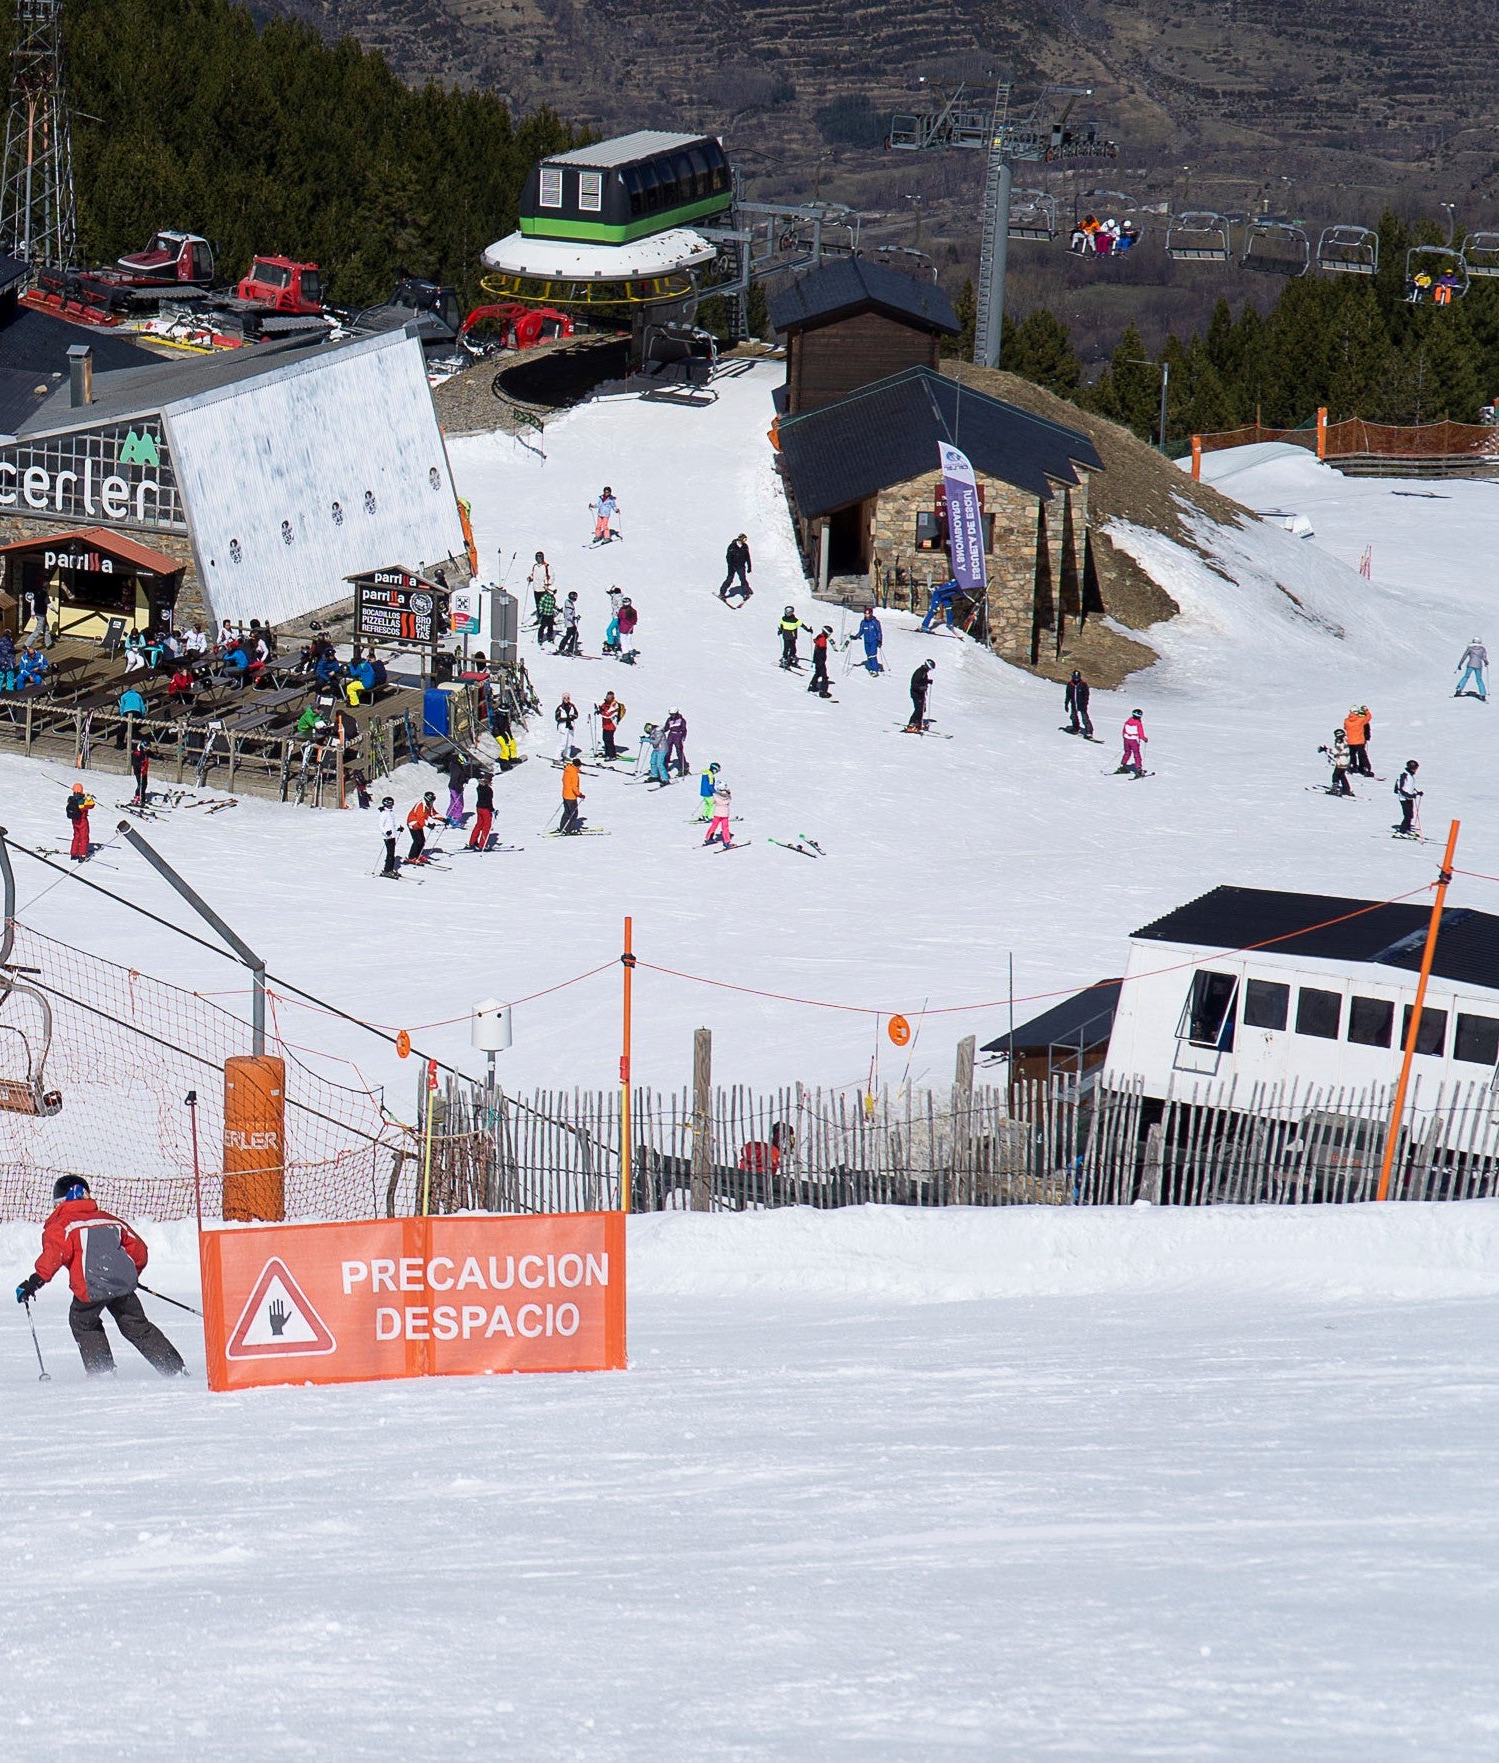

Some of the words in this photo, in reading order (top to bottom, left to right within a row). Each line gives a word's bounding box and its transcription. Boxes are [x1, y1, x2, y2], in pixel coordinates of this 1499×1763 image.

[44, 551, 113, 574] parrilla
[374, 572, 417, 587] parrilla
[362, 590, 405, 604] parrilla
[362, 607, 401, 620] BOCADILLOS
[362, 615, 401, 628] PIZZELLAS
[361, 623, 401, 636] REFRESCOS
[341, 1253, 609, 1294] PRECAUCION
[376, 1302, 580, 1341] DESPACIO
